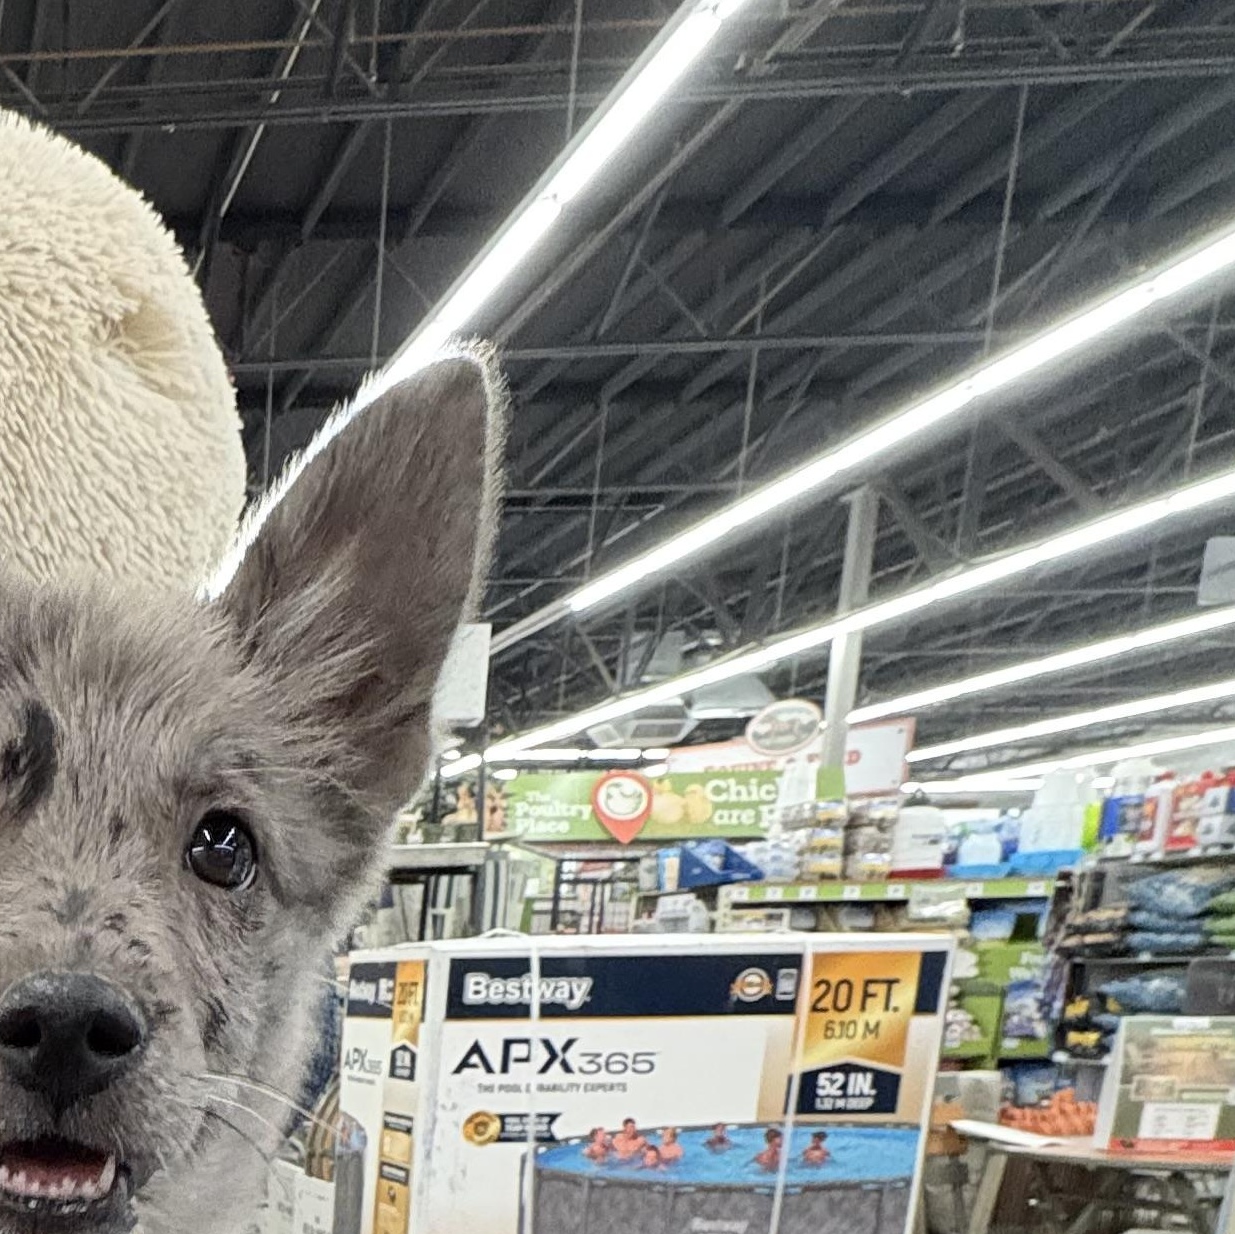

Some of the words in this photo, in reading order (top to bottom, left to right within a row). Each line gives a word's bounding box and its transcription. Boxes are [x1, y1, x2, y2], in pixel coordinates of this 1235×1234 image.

[526, 790, 552, 803] The
[514, 801, 592, 823] Poultry
[713, 808, 755, 826] are
[515, 816, 570, 834] Place
[465, 973, 592, 1009] Bestway
[811, 978, 854, 1013] 20
[860, 977, 901, 1013] FT.
[862, 1020, 881, 1040] M
[816, 1071, 844, 1097] 52
[847, 1072, 877, 1097] IN.
